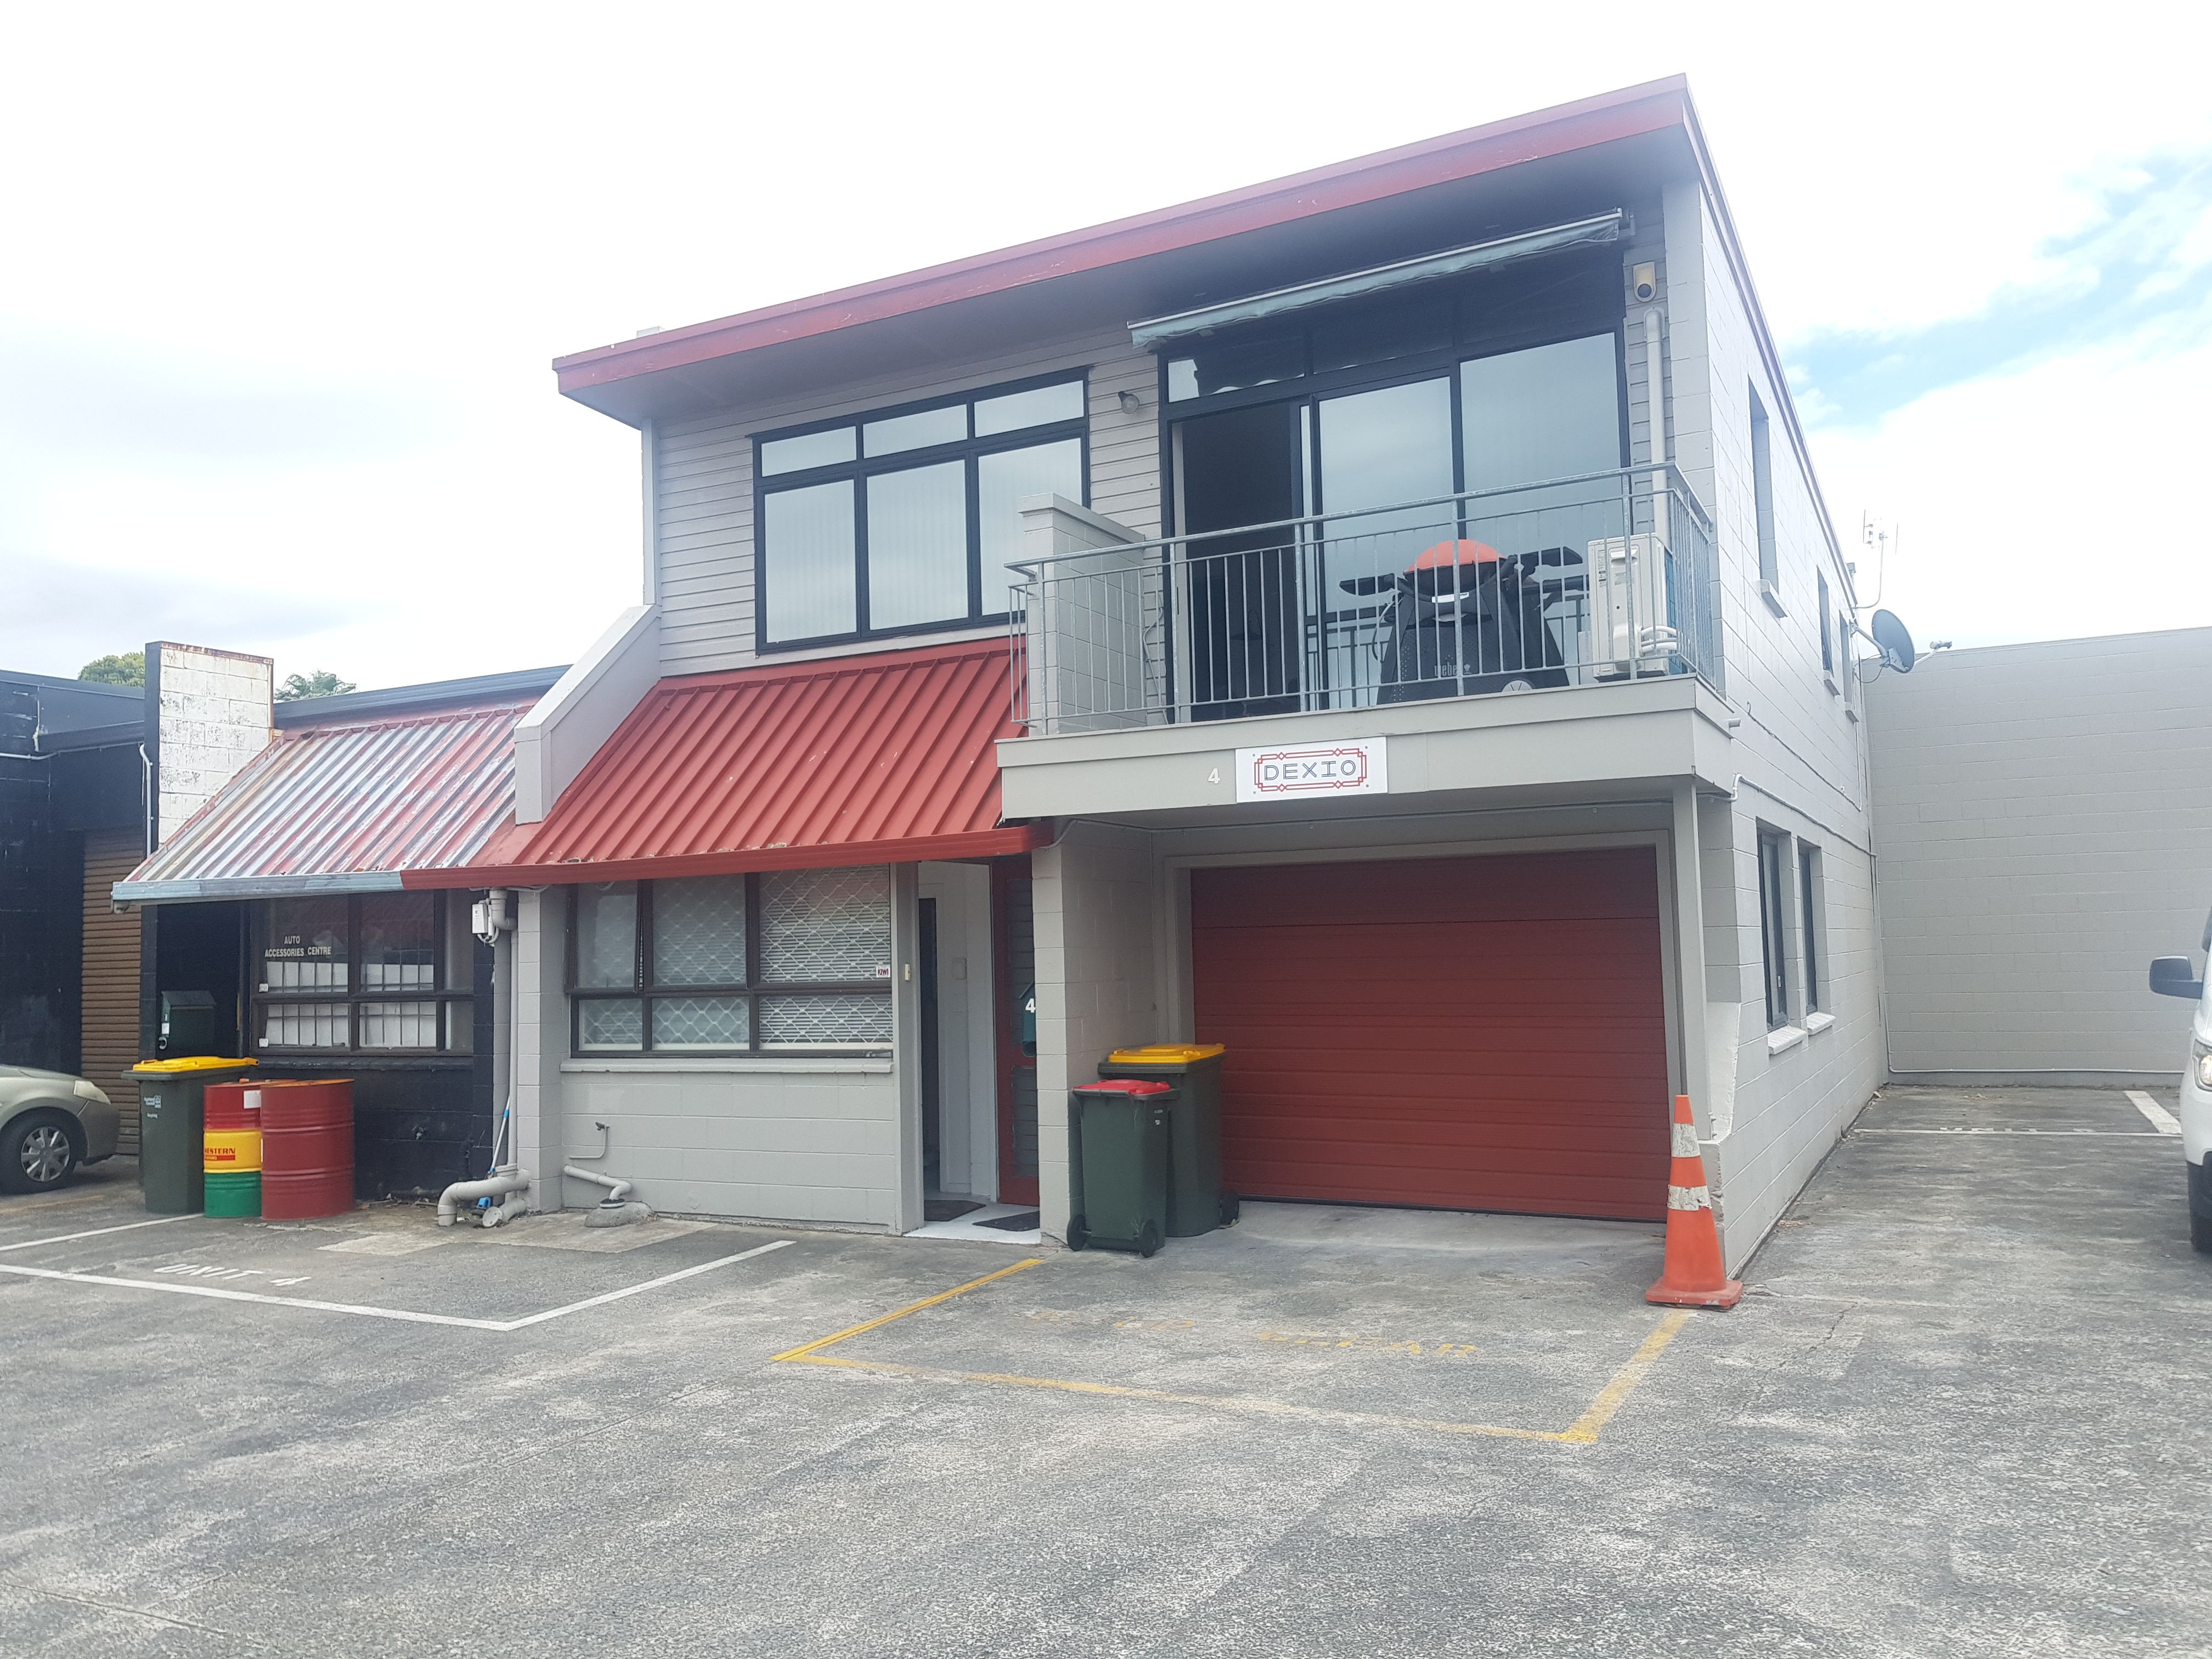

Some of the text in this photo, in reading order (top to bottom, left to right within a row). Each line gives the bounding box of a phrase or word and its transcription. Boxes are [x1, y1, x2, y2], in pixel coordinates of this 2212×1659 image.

[1207, 768, 1221, 785] 4
[1263, 759, 1356, 781] DEXIO
[284, 935, 301, 944] AUTO
[264, 946, 332, 957] ACCESSORIES CENTRE
[1025, 998, 1036, 1013] 4
[153, 1263, 312, 1286] UNIT 4
